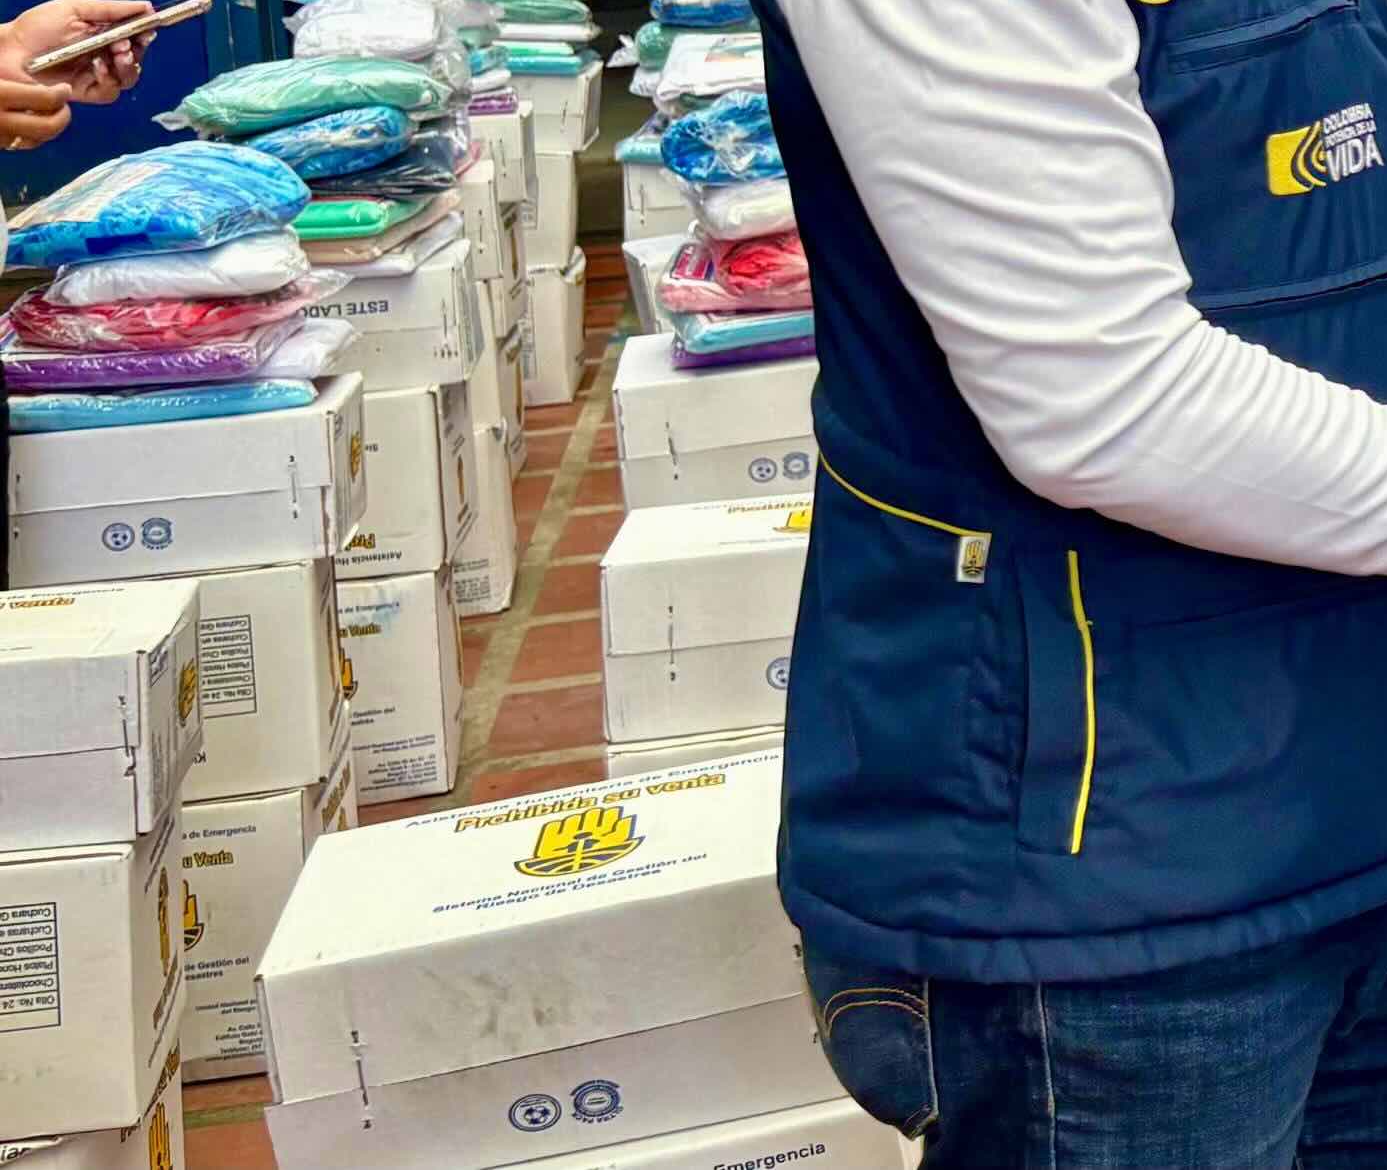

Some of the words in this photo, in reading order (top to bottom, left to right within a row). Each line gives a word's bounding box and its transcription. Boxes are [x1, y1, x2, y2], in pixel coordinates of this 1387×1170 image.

[1327, 134, 1385, 182] VIDA
[347, 299, 389, 315] ESTE
[454, 795, 599, 833] Prohibida
[602, 787, 641, 804] su
[432, 894, 502, 913] Sistema
[507, 877, 581, 898] Nacional
[587, 873, 607, 881] de
[612, 860, 677, 877] Gestión
[682, 853, 708, 864] del
[476, 894, 540, 911] Riesgo
[545, 887, 567, 896] de
[572, 869, 662, 892] Desastres
[8, 925, 52, 936] Cucharas
